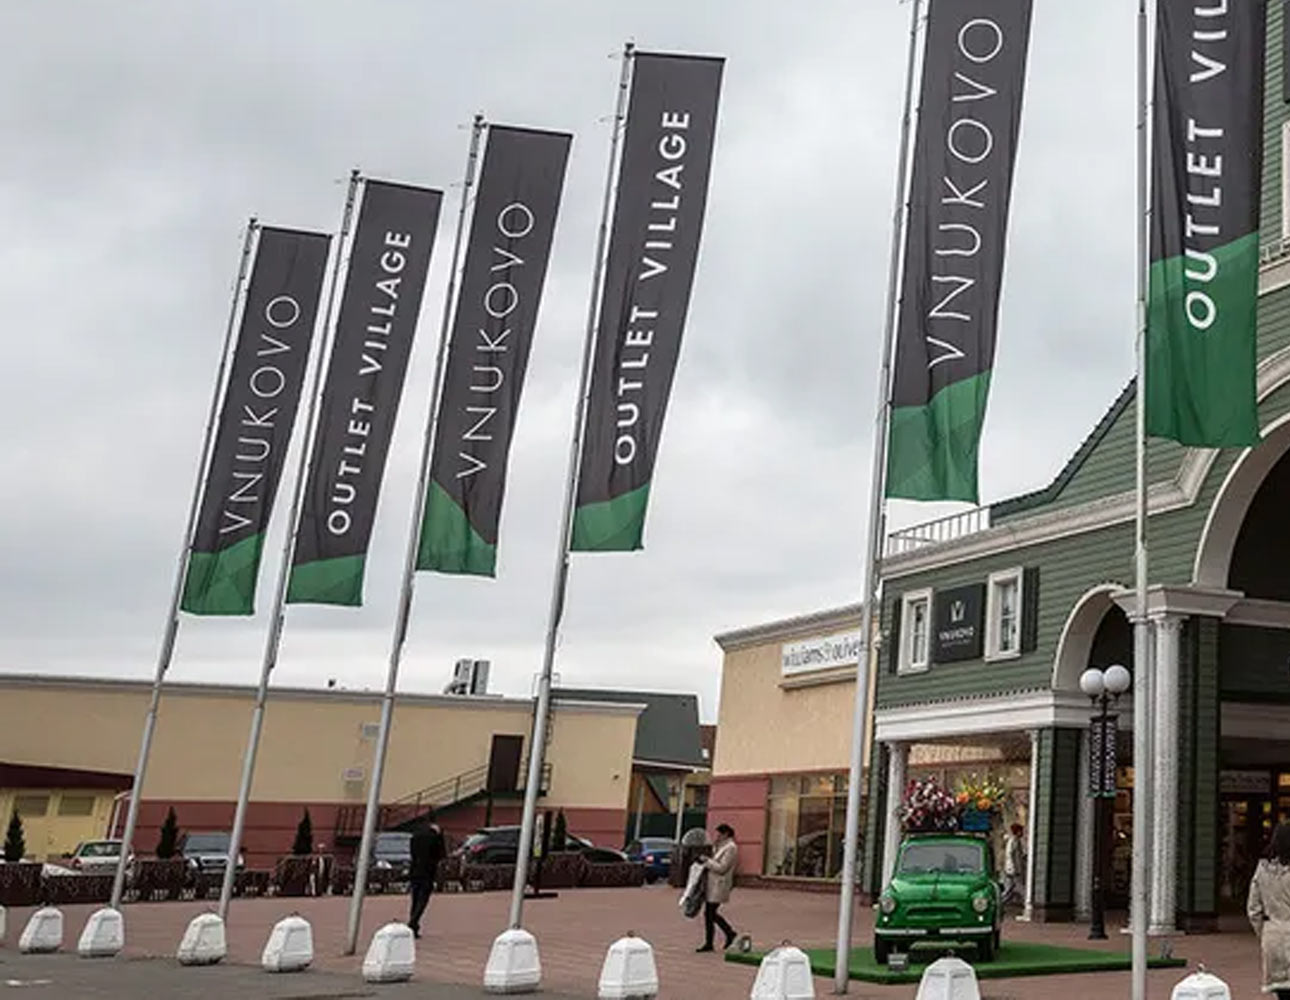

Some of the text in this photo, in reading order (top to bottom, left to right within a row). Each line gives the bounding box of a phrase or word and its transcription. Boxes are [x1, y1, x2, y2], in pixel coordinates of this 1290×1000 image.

[614, 110, 690, 465] OUTLET VILLAGE
[926, 18, 1003, 368] VNUKOVO
[1185, 118, 1225, 328] OUTLET
[219, 295, 300, 535] VNUKOVO
[327, 229, 412, 536] OUTLET VILLAGE
[456, 202, 535, 479] VNUKOVO
